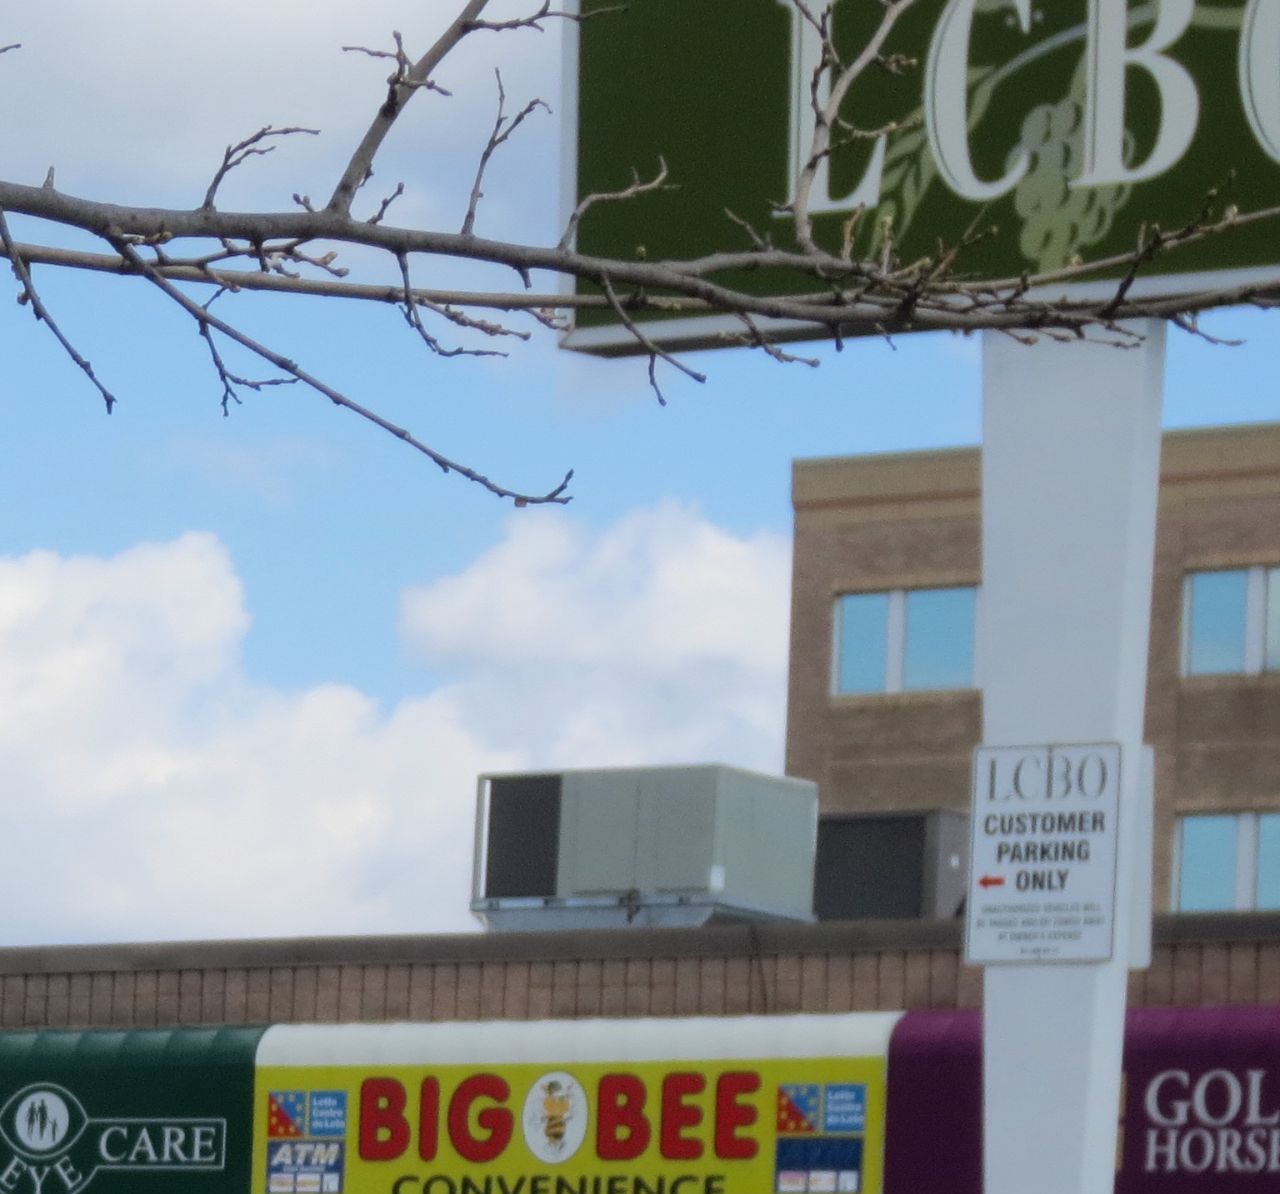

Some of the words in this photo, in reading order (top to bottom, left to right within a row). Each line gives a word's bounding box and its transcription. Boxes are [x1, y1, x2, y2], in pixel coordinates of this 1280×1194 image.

[772, 0, 1280, 218] LCB
[989, 753, 1108, 801] LCBO
[984, 811, 1106, 836] CUSTOMER
[996, 840, 1090, 863] PARKING
[1016, 869, 1069, 892] ONLY
[357, 1073, 515, 1163] BIG
[594, 1071, 762, 1162] BEE
[99, 1126, 216, 1162] CARE
[270, 1143, 340, 1166] ATM
